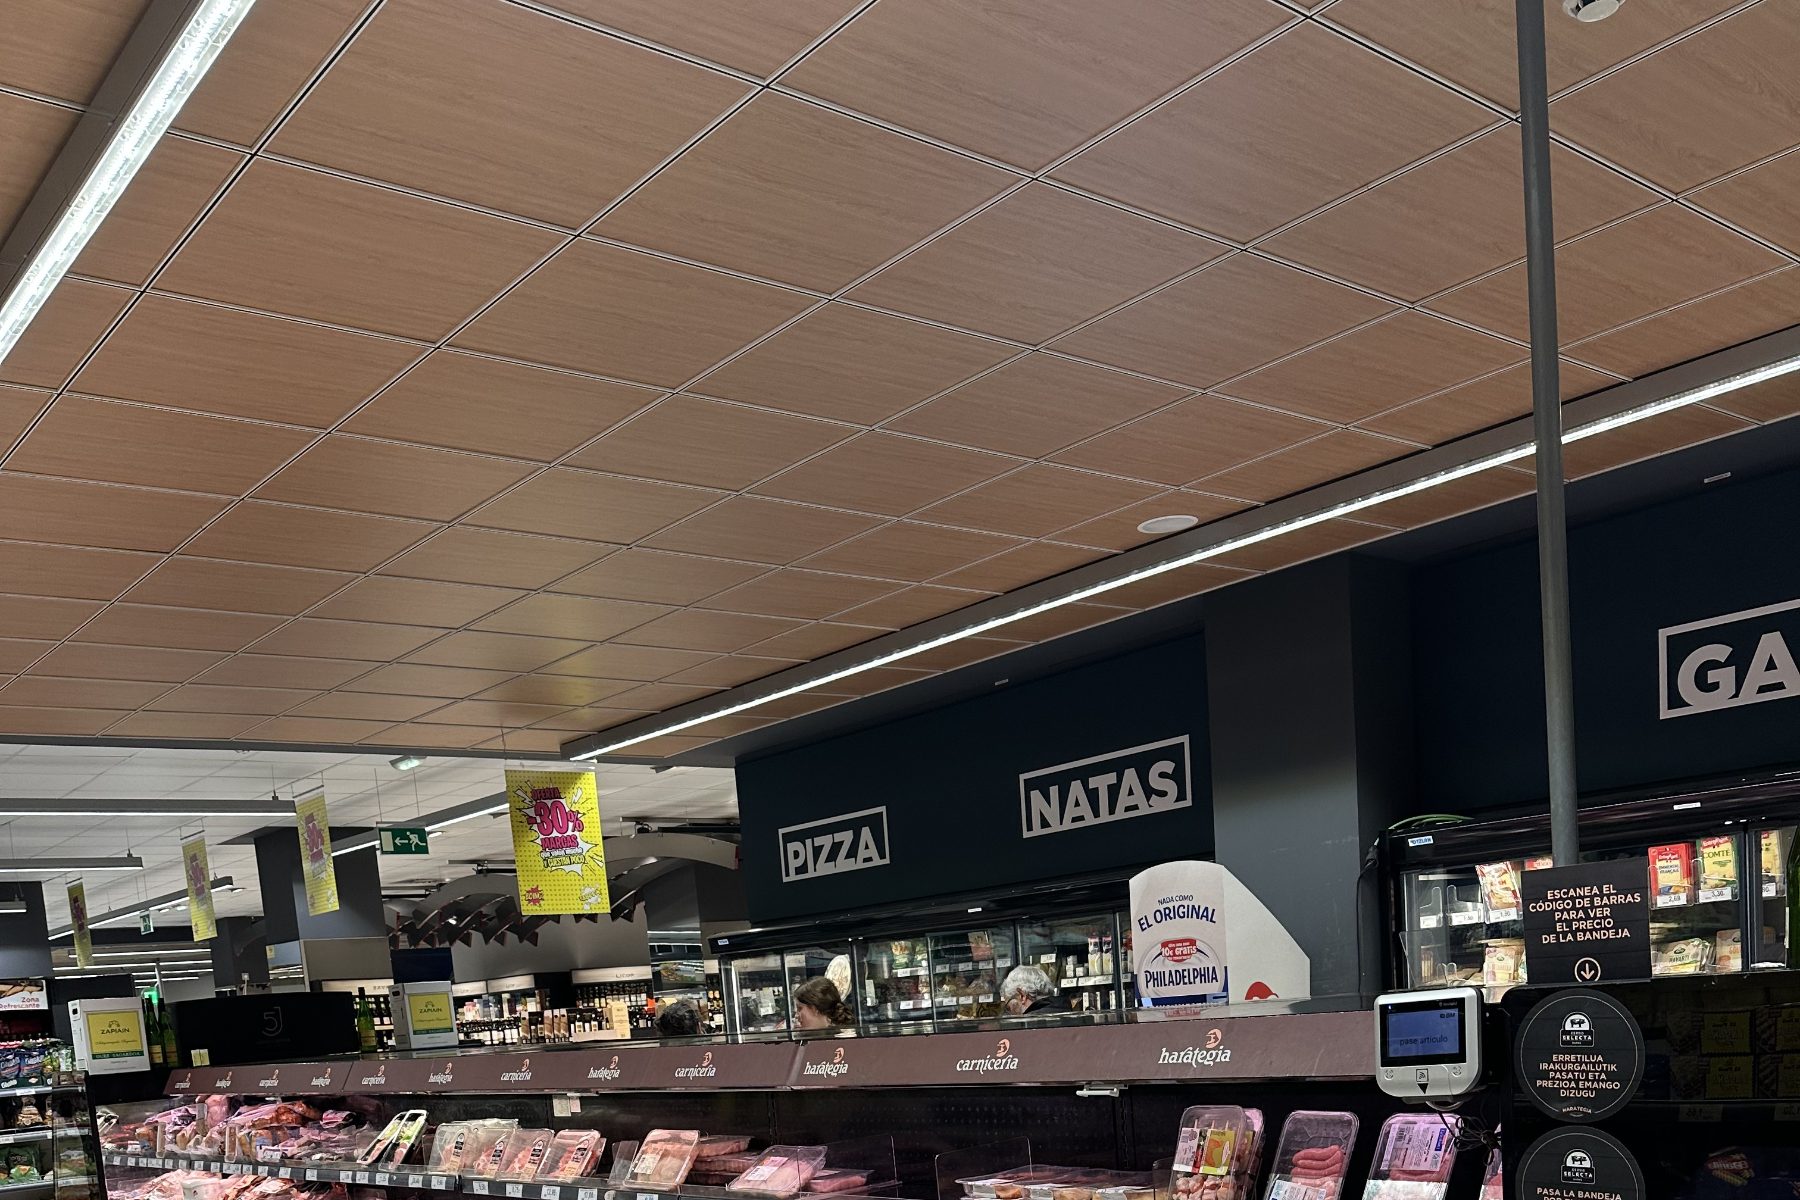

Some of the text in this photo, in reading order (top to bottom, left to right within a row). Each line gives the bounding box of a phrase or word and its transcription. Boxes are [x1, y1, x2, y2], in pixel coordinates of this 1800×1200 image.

[531, 787, 561, 799] OFERTA
[1029, 760, 1178, 831] NATAS
[527, 800, 584, 836] -30%
[541, 834, 579, 850] MARCAS
[786, 826, 881, 877] PIZZA
[1547, 884, 1617, 900] ESCANEA EL
[1157, 894, 1194, 905] NADA COMO
[1529, 893, 1641, 912] CÓDIGO DE BARRAS
[1137, 904, 1217, 932] EL ORIGINAL
[1554, 907, 1611, 921] PARA VER
[1556, 918, 1614, 932] EL PRECIO
[1541, 928, 1631, 944] DE LA BANDEJA
[1144, 966, 1219, 989] PHILADELPHIA
[100, 1027, 130, 1035] ZAPIAIN
[1400, 1038, 1418, 1047] pase
[1552, 1054, 1604, 1062] ERRETILUA
[1539, 1062, 1618, 1072] IRAKURGAILUTIK
[1549, 1071, 1607, 1080] PASATU ETA
[1536, 1080, 1621, 1090] PREZIOA EMANGO
[1560, 1089, 1596, 1098] DIZUGU
[1562, 1106, 1592, 1114] HARATEGIA
[1536, 1187, 1622, 1200] PASA LA BANDEJA
